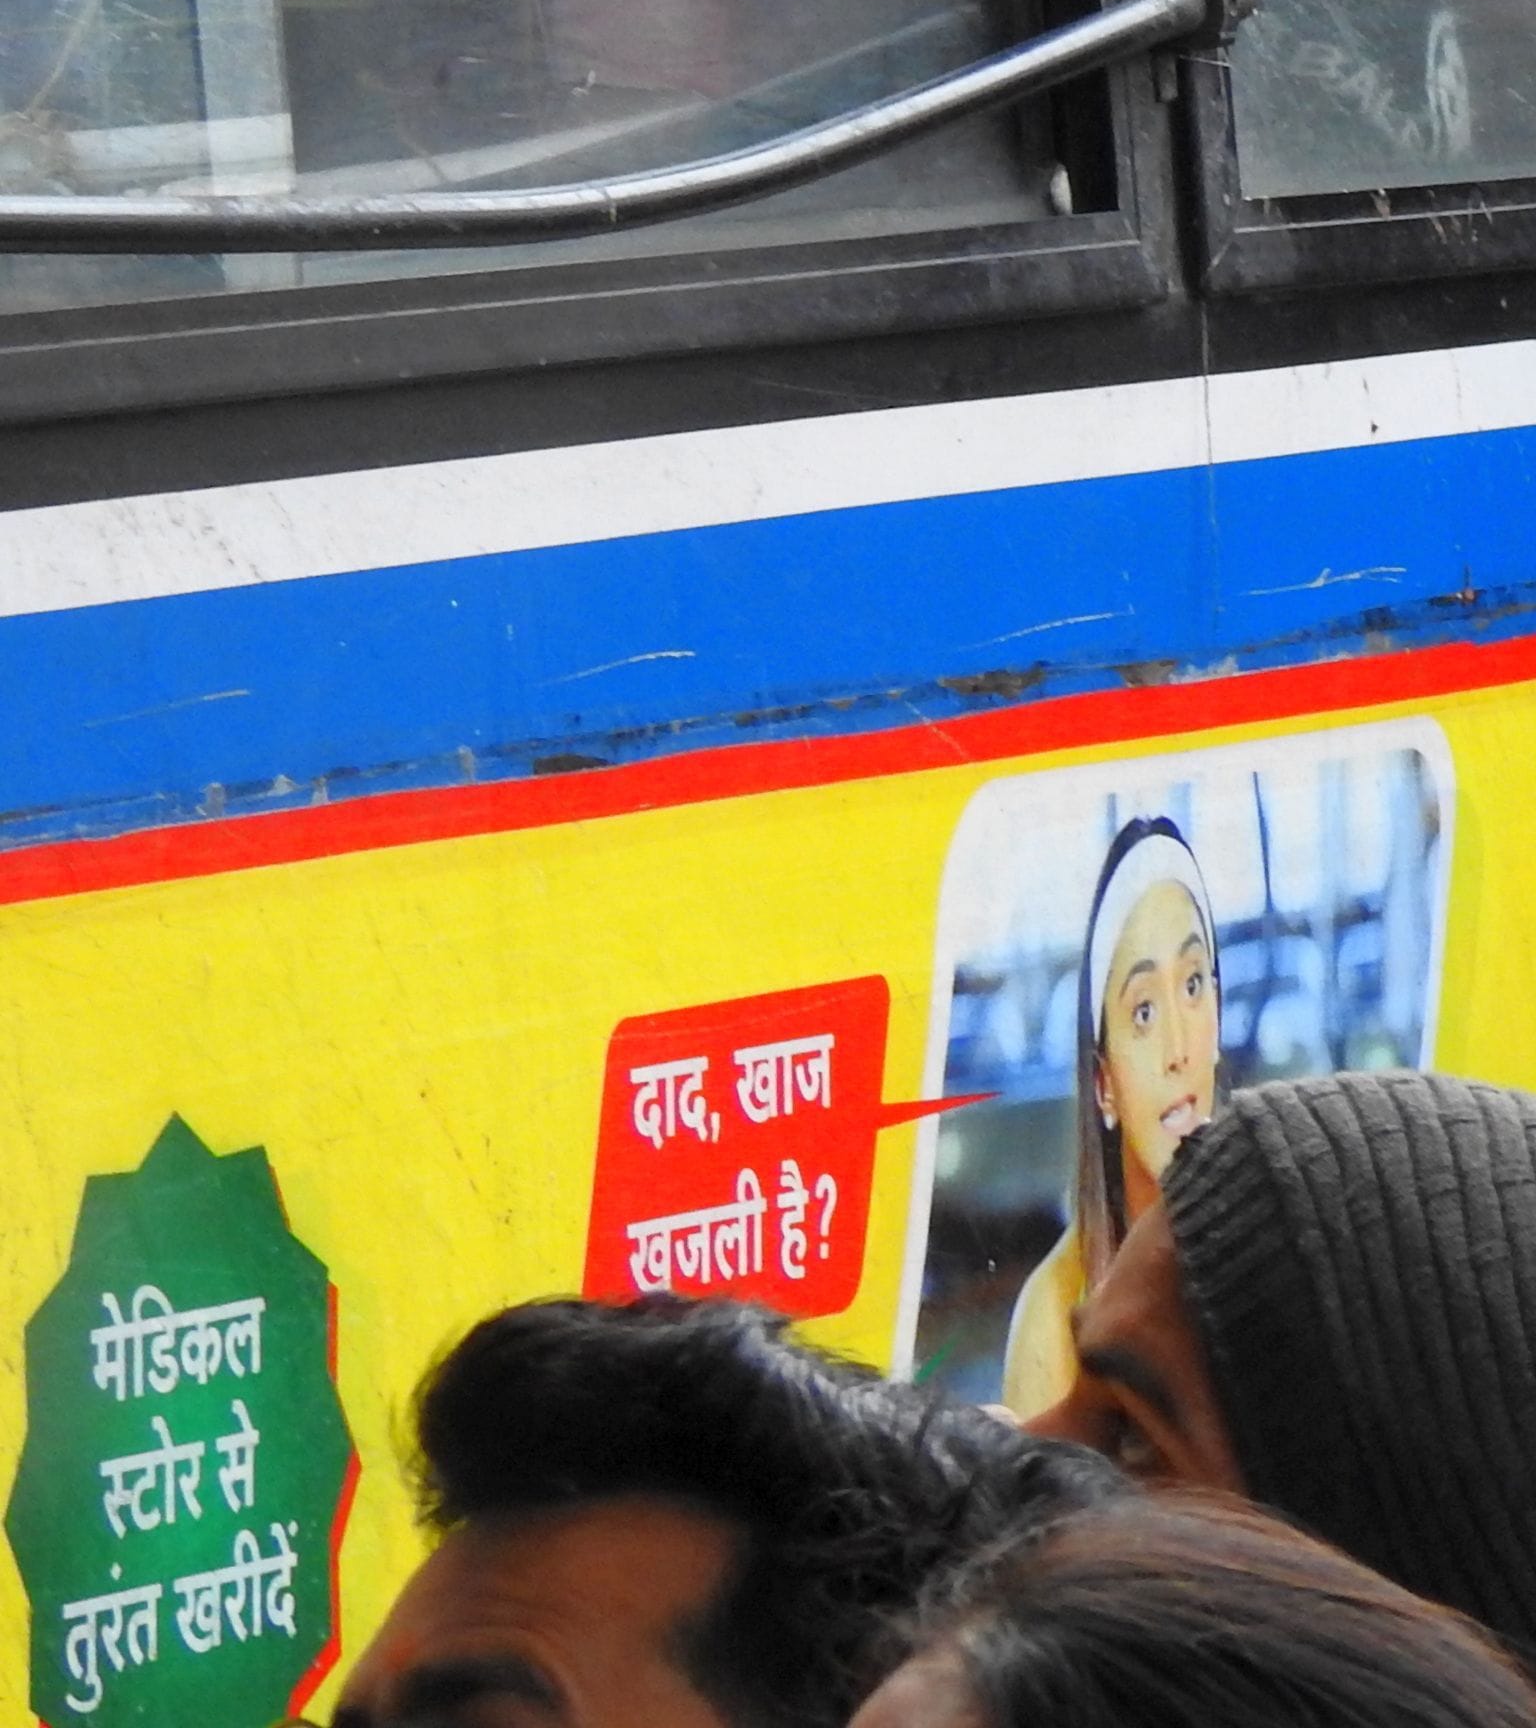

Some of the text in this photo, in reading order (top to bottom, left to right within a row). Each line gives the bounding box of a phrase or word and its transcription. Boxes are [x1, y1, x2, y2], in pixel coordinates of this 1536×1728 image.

[631, 1034, 836, 1149] दाद, खाज
[777, 1159, 838, 1280] है?
[92, 1286, 266, 1402] मेडिकल
[100, 1399, 258, 1540] स्टोर से
[62, 1520, 299, 1713] तुरंत खरीदें
